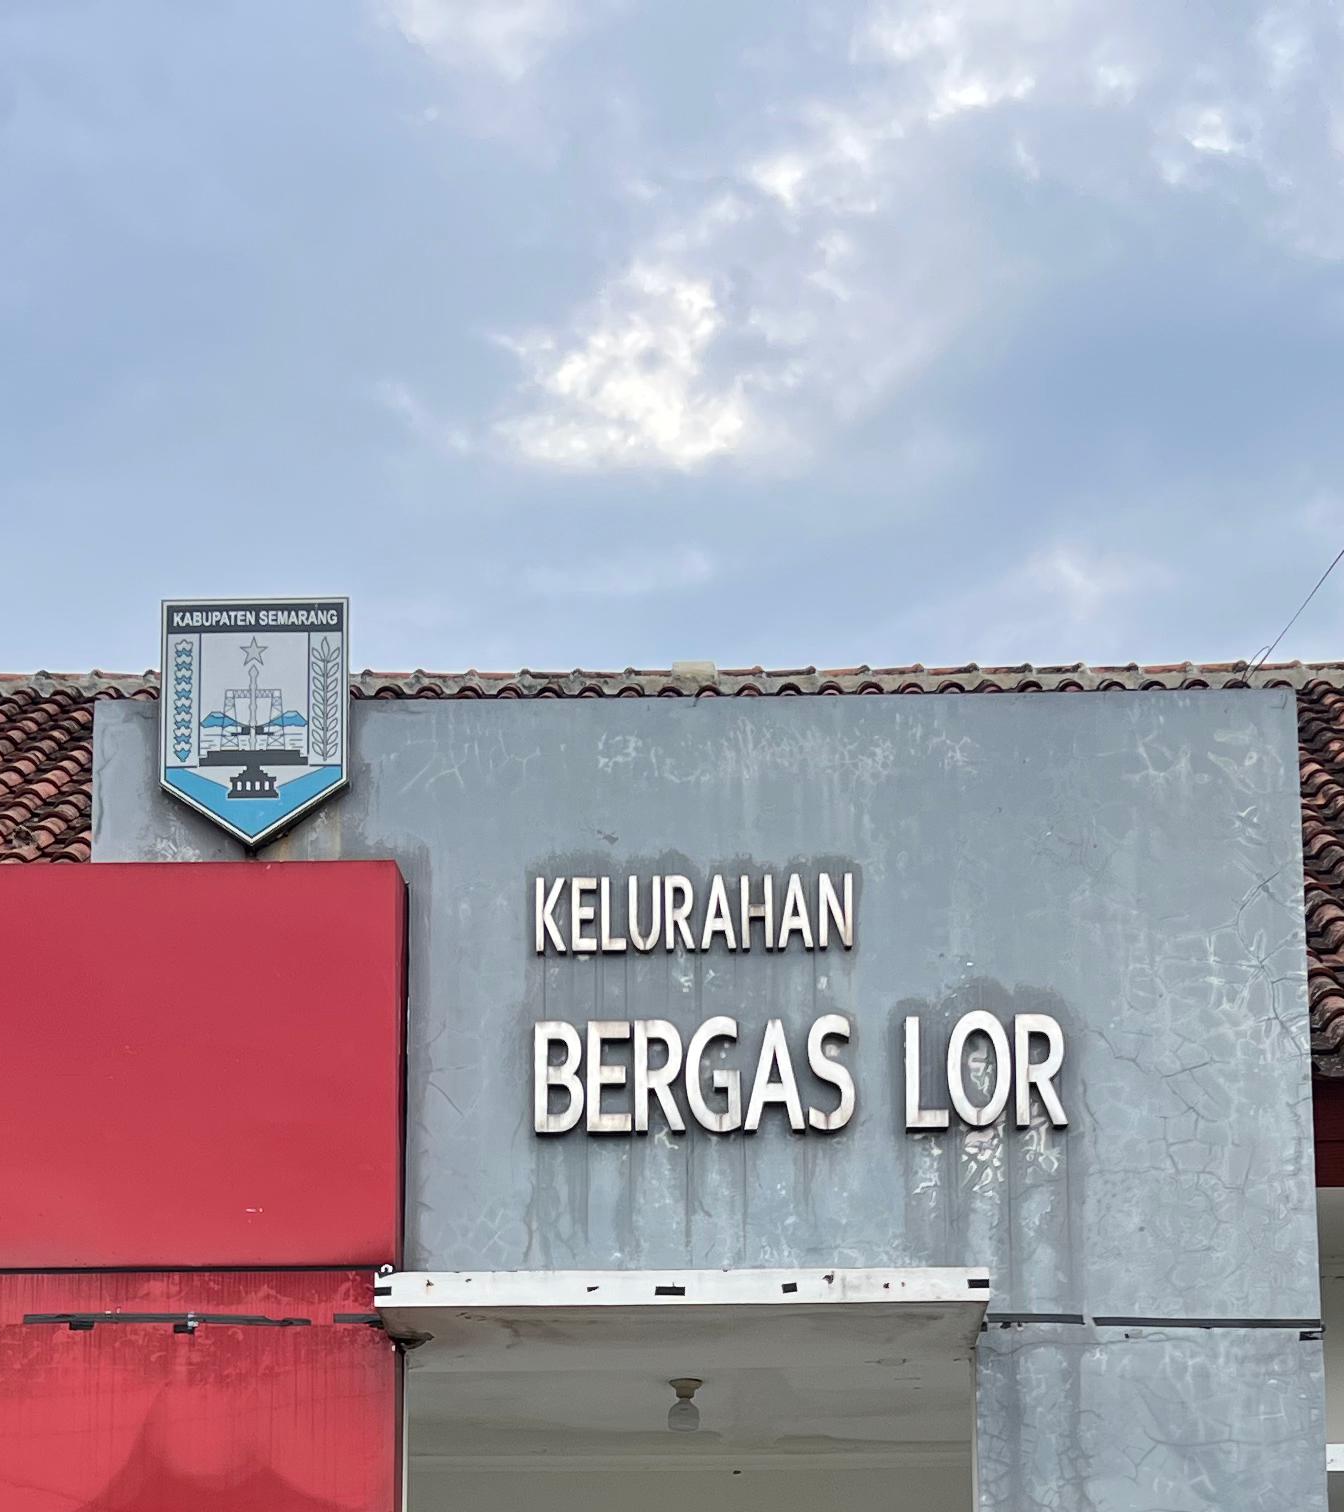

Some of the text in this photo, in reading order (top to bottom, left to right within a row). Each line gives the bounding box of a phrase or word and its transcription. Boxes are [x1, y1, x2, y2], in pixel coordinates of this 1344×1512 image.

[173, 609, 338, 627] KABUPATEN SEMARANG
[533, 872, 855, 954] KELURAHAN
[533, 1009, 1070, 1135] BERGAS LOR
